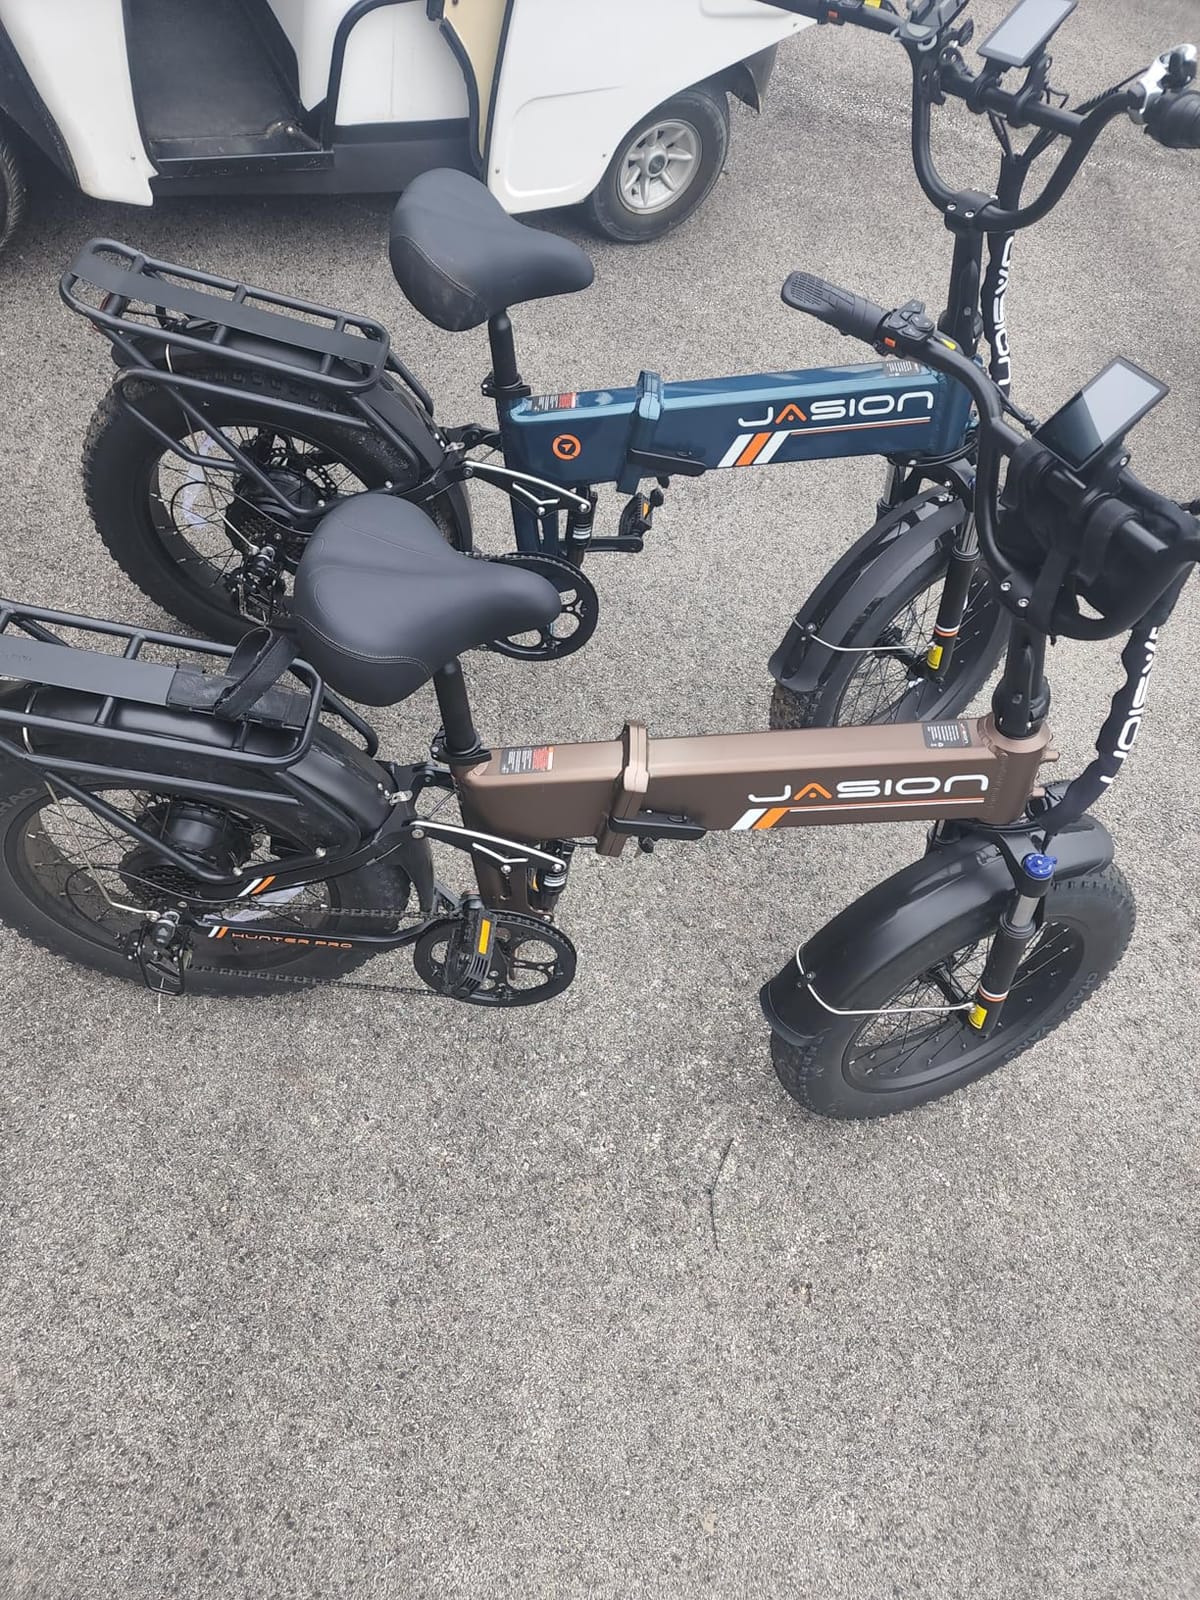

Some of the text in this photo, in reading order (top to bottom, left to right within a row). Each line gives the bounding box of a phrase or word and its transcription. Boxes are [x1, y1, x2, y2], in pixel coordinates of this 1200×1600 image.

[738, 390, 934, 428] JASION
[748, 774, 989, 803] JASION
[231, 932, 353, 949] HUNTER PRO
